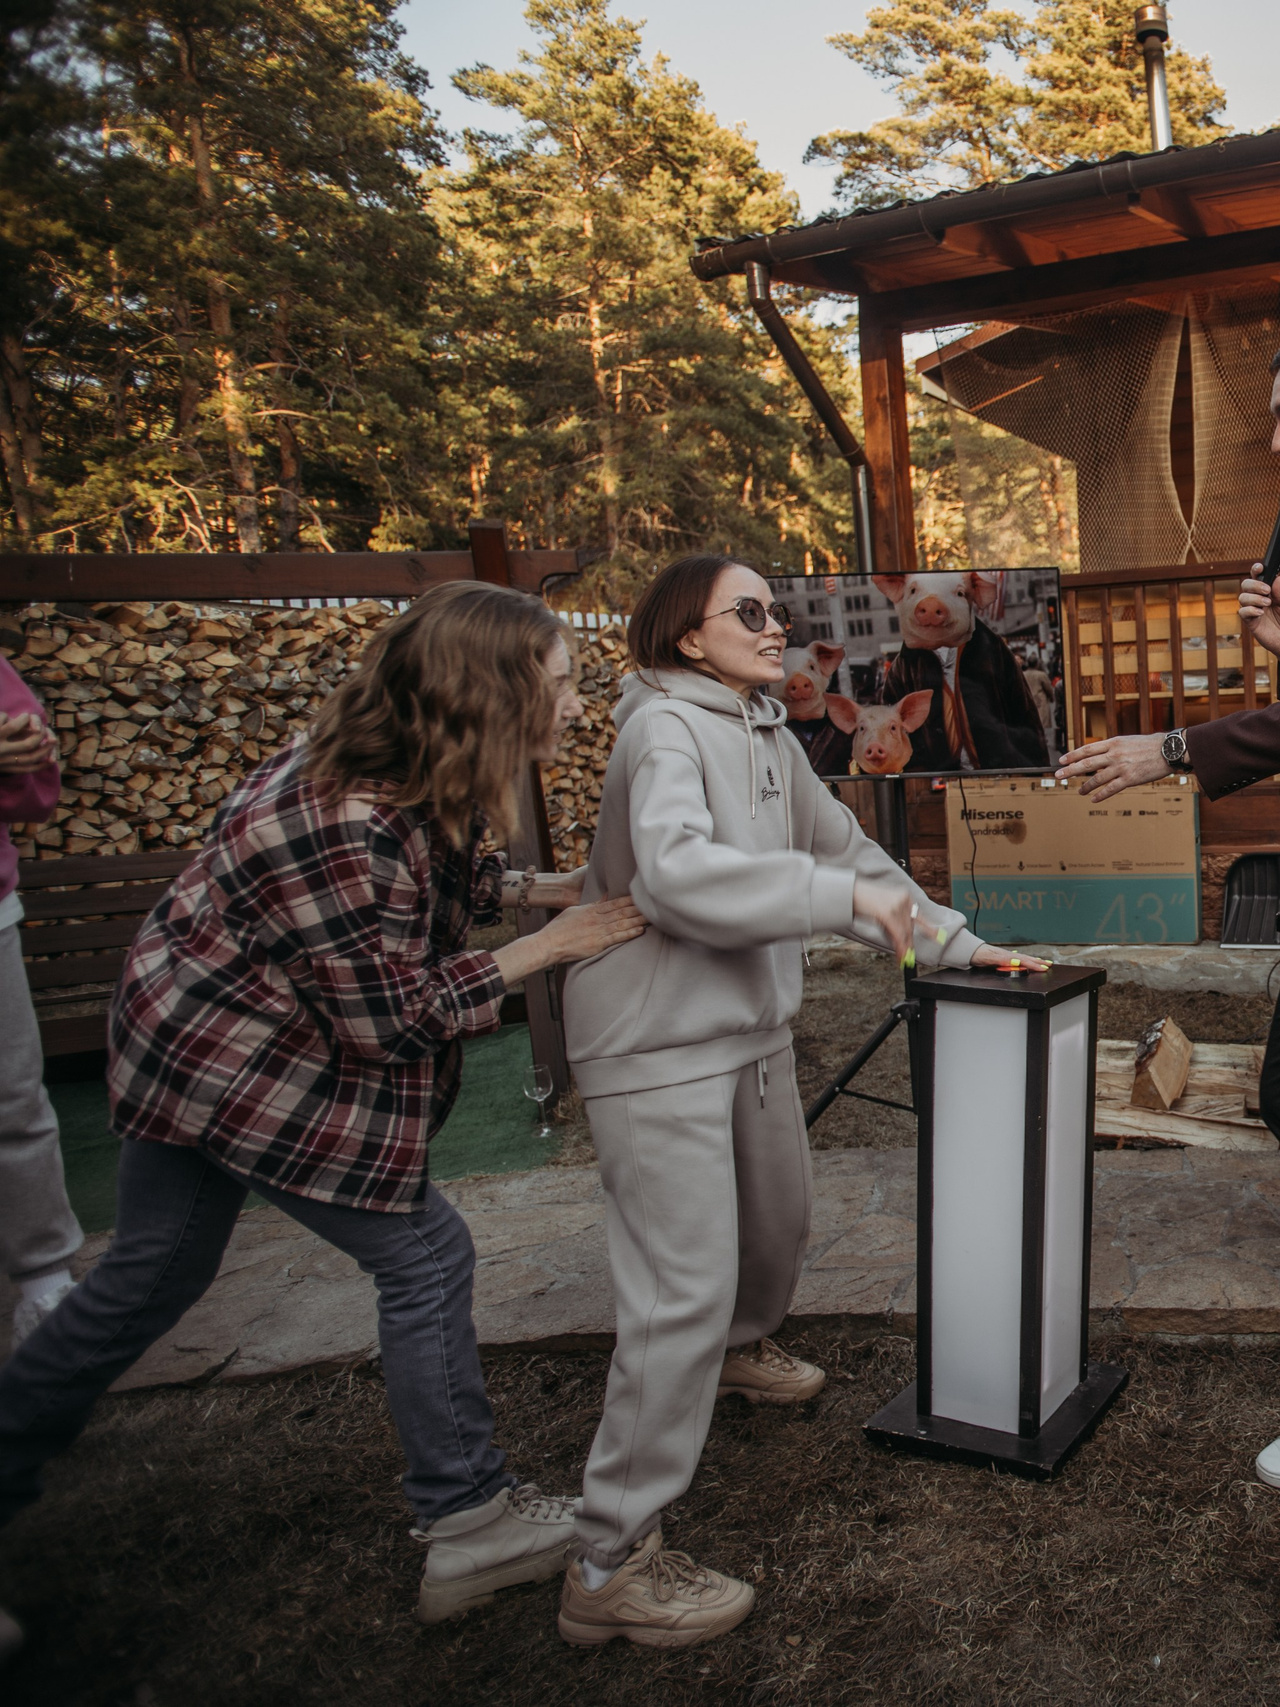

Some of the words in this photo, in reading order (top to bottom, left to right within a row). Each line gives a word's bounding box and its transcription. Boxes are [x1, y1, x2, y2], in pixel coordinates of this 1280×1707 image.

[961, 809, 1024, 820] Hisense
[964, 891, 1047, 910] SMART
[1053, 892, 1076, 910] TV
